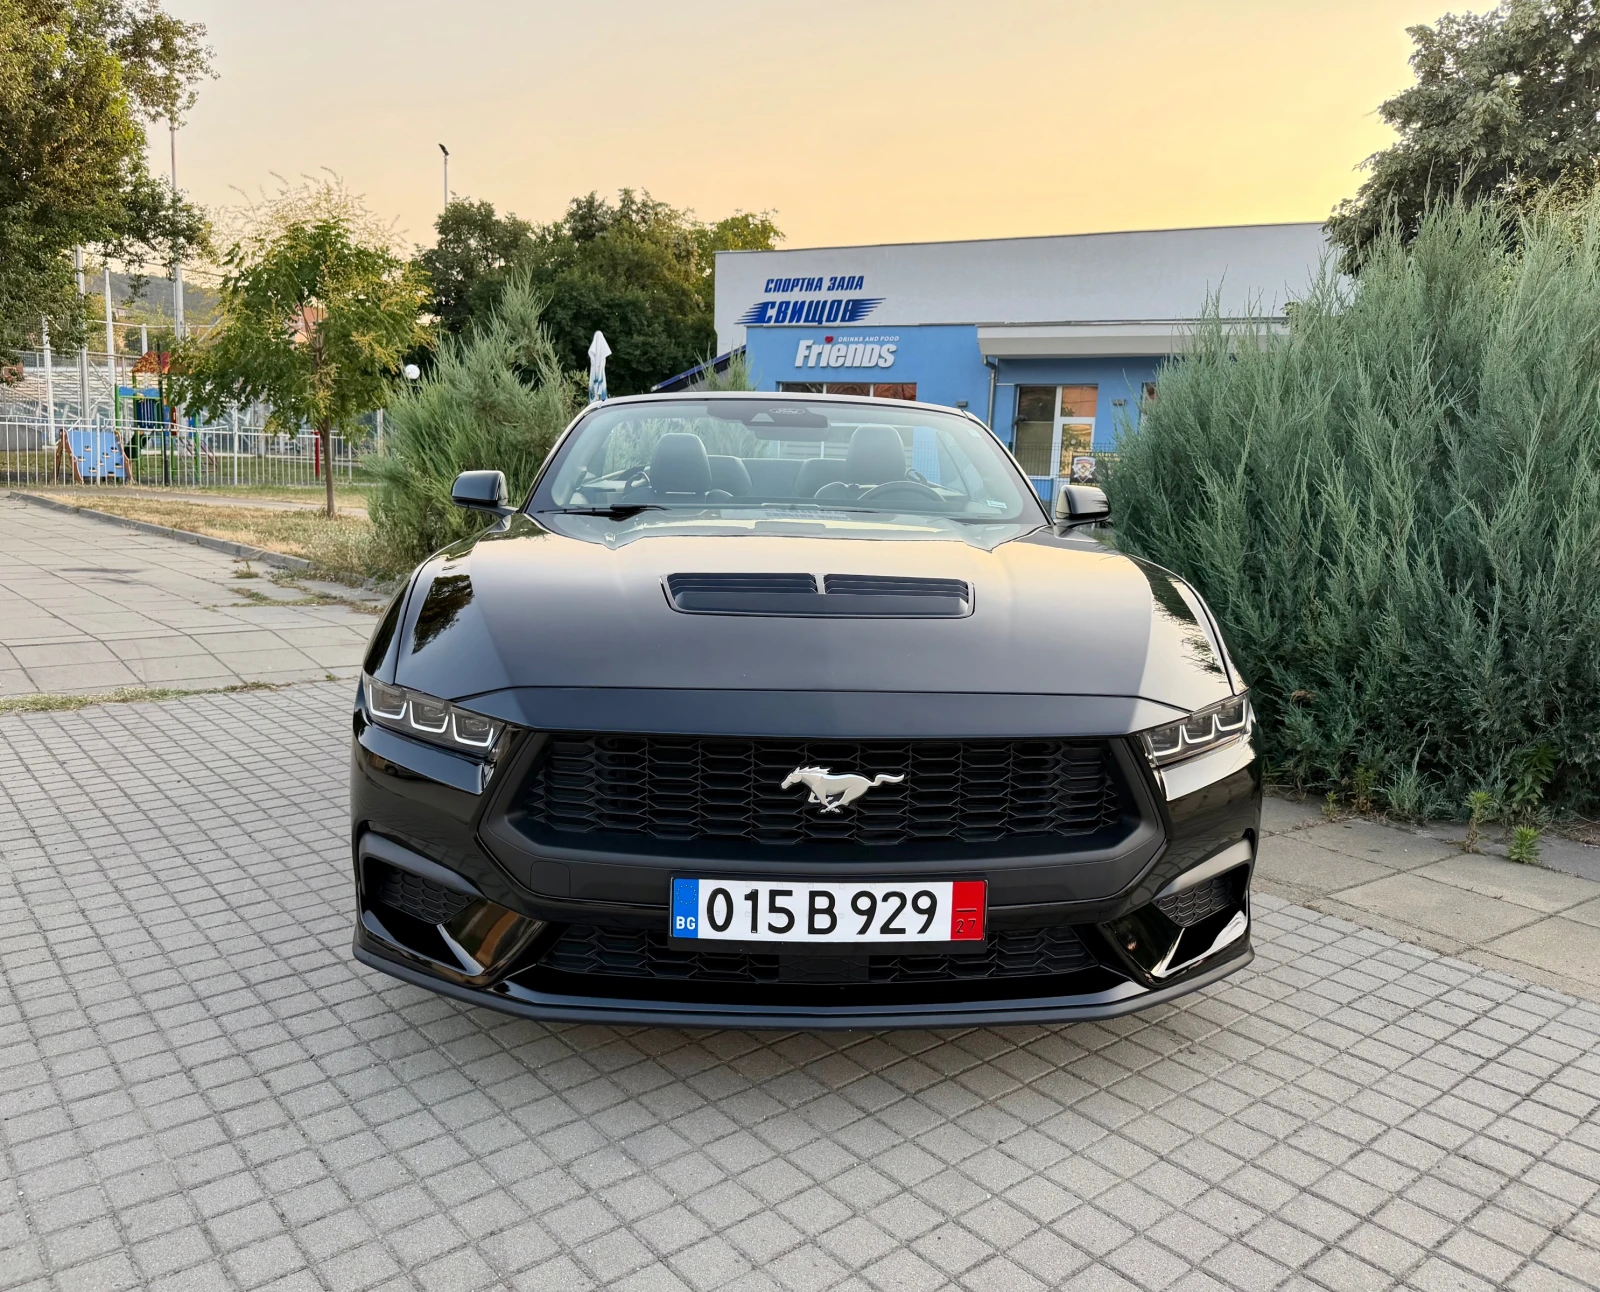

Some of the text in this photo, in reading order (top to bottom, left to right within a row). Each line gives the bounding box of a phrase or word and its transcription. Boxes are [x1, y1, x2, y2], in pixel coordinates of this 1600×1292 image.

[764, 275, 864, 293] СПОРТНА ЗАЛА
[748, 298, 870, 325] СВИЩОВ
[706, 887, 795, 934] 015
[850, 890, 938, 936] 929
[676, 917, 696, 930] BG
[956, 918, 977, 934] 27
